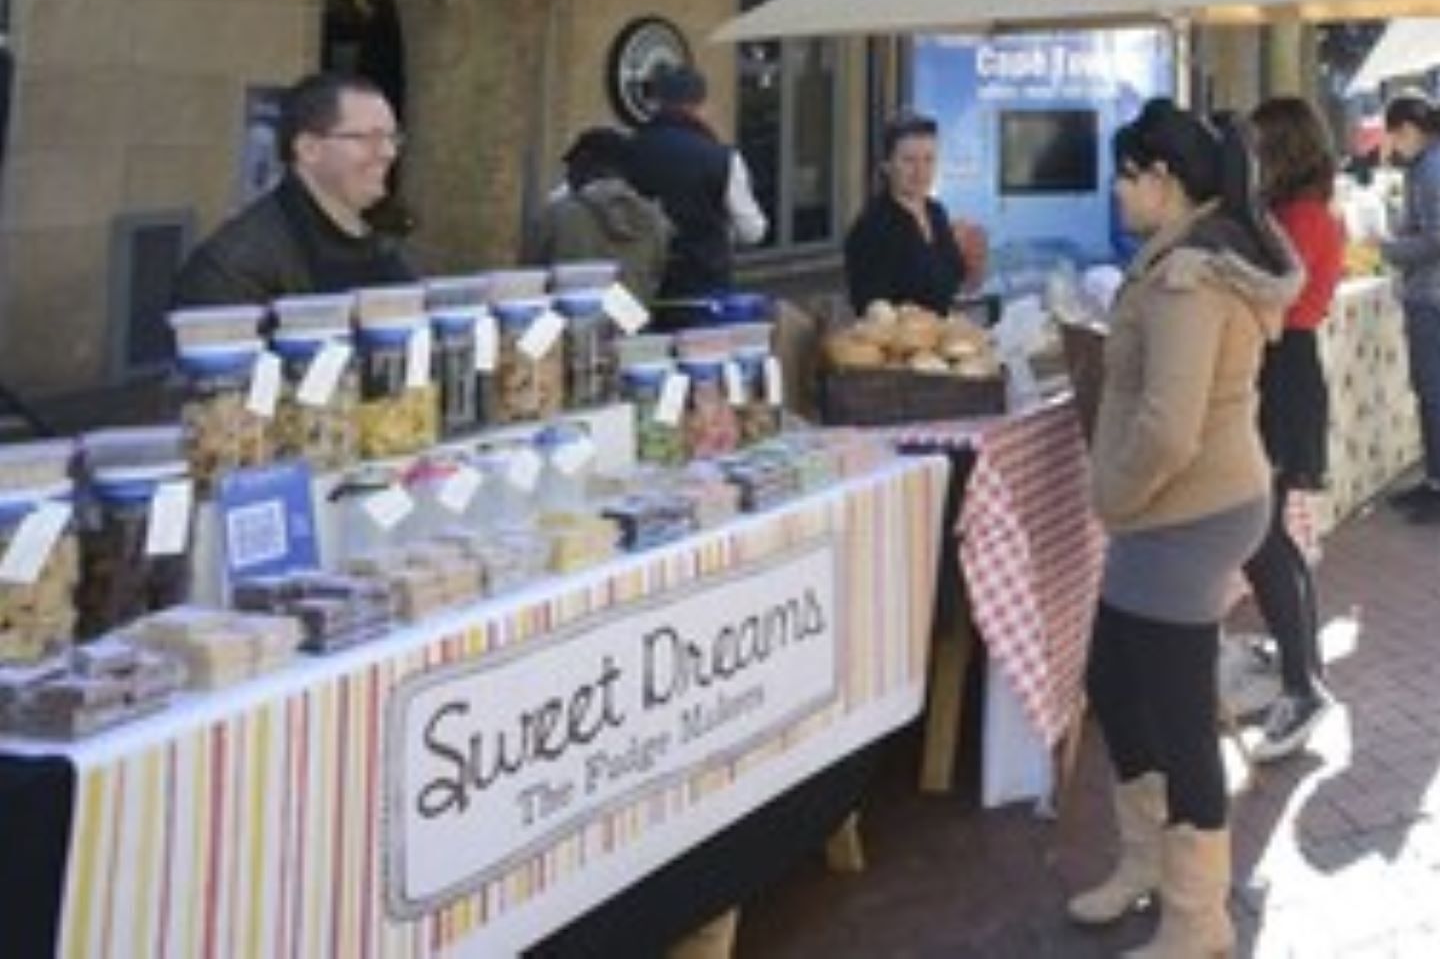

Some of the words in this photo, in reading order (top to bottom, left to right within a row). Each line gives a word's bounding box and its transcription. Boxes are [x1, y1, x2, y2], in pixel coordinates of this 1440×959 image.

[417, 656, 626, 819] Sweet
[641, 587, 826, 710] Dreams
[516, 779, 575, 826] The
[583, 731, 671, 795] Fudge
